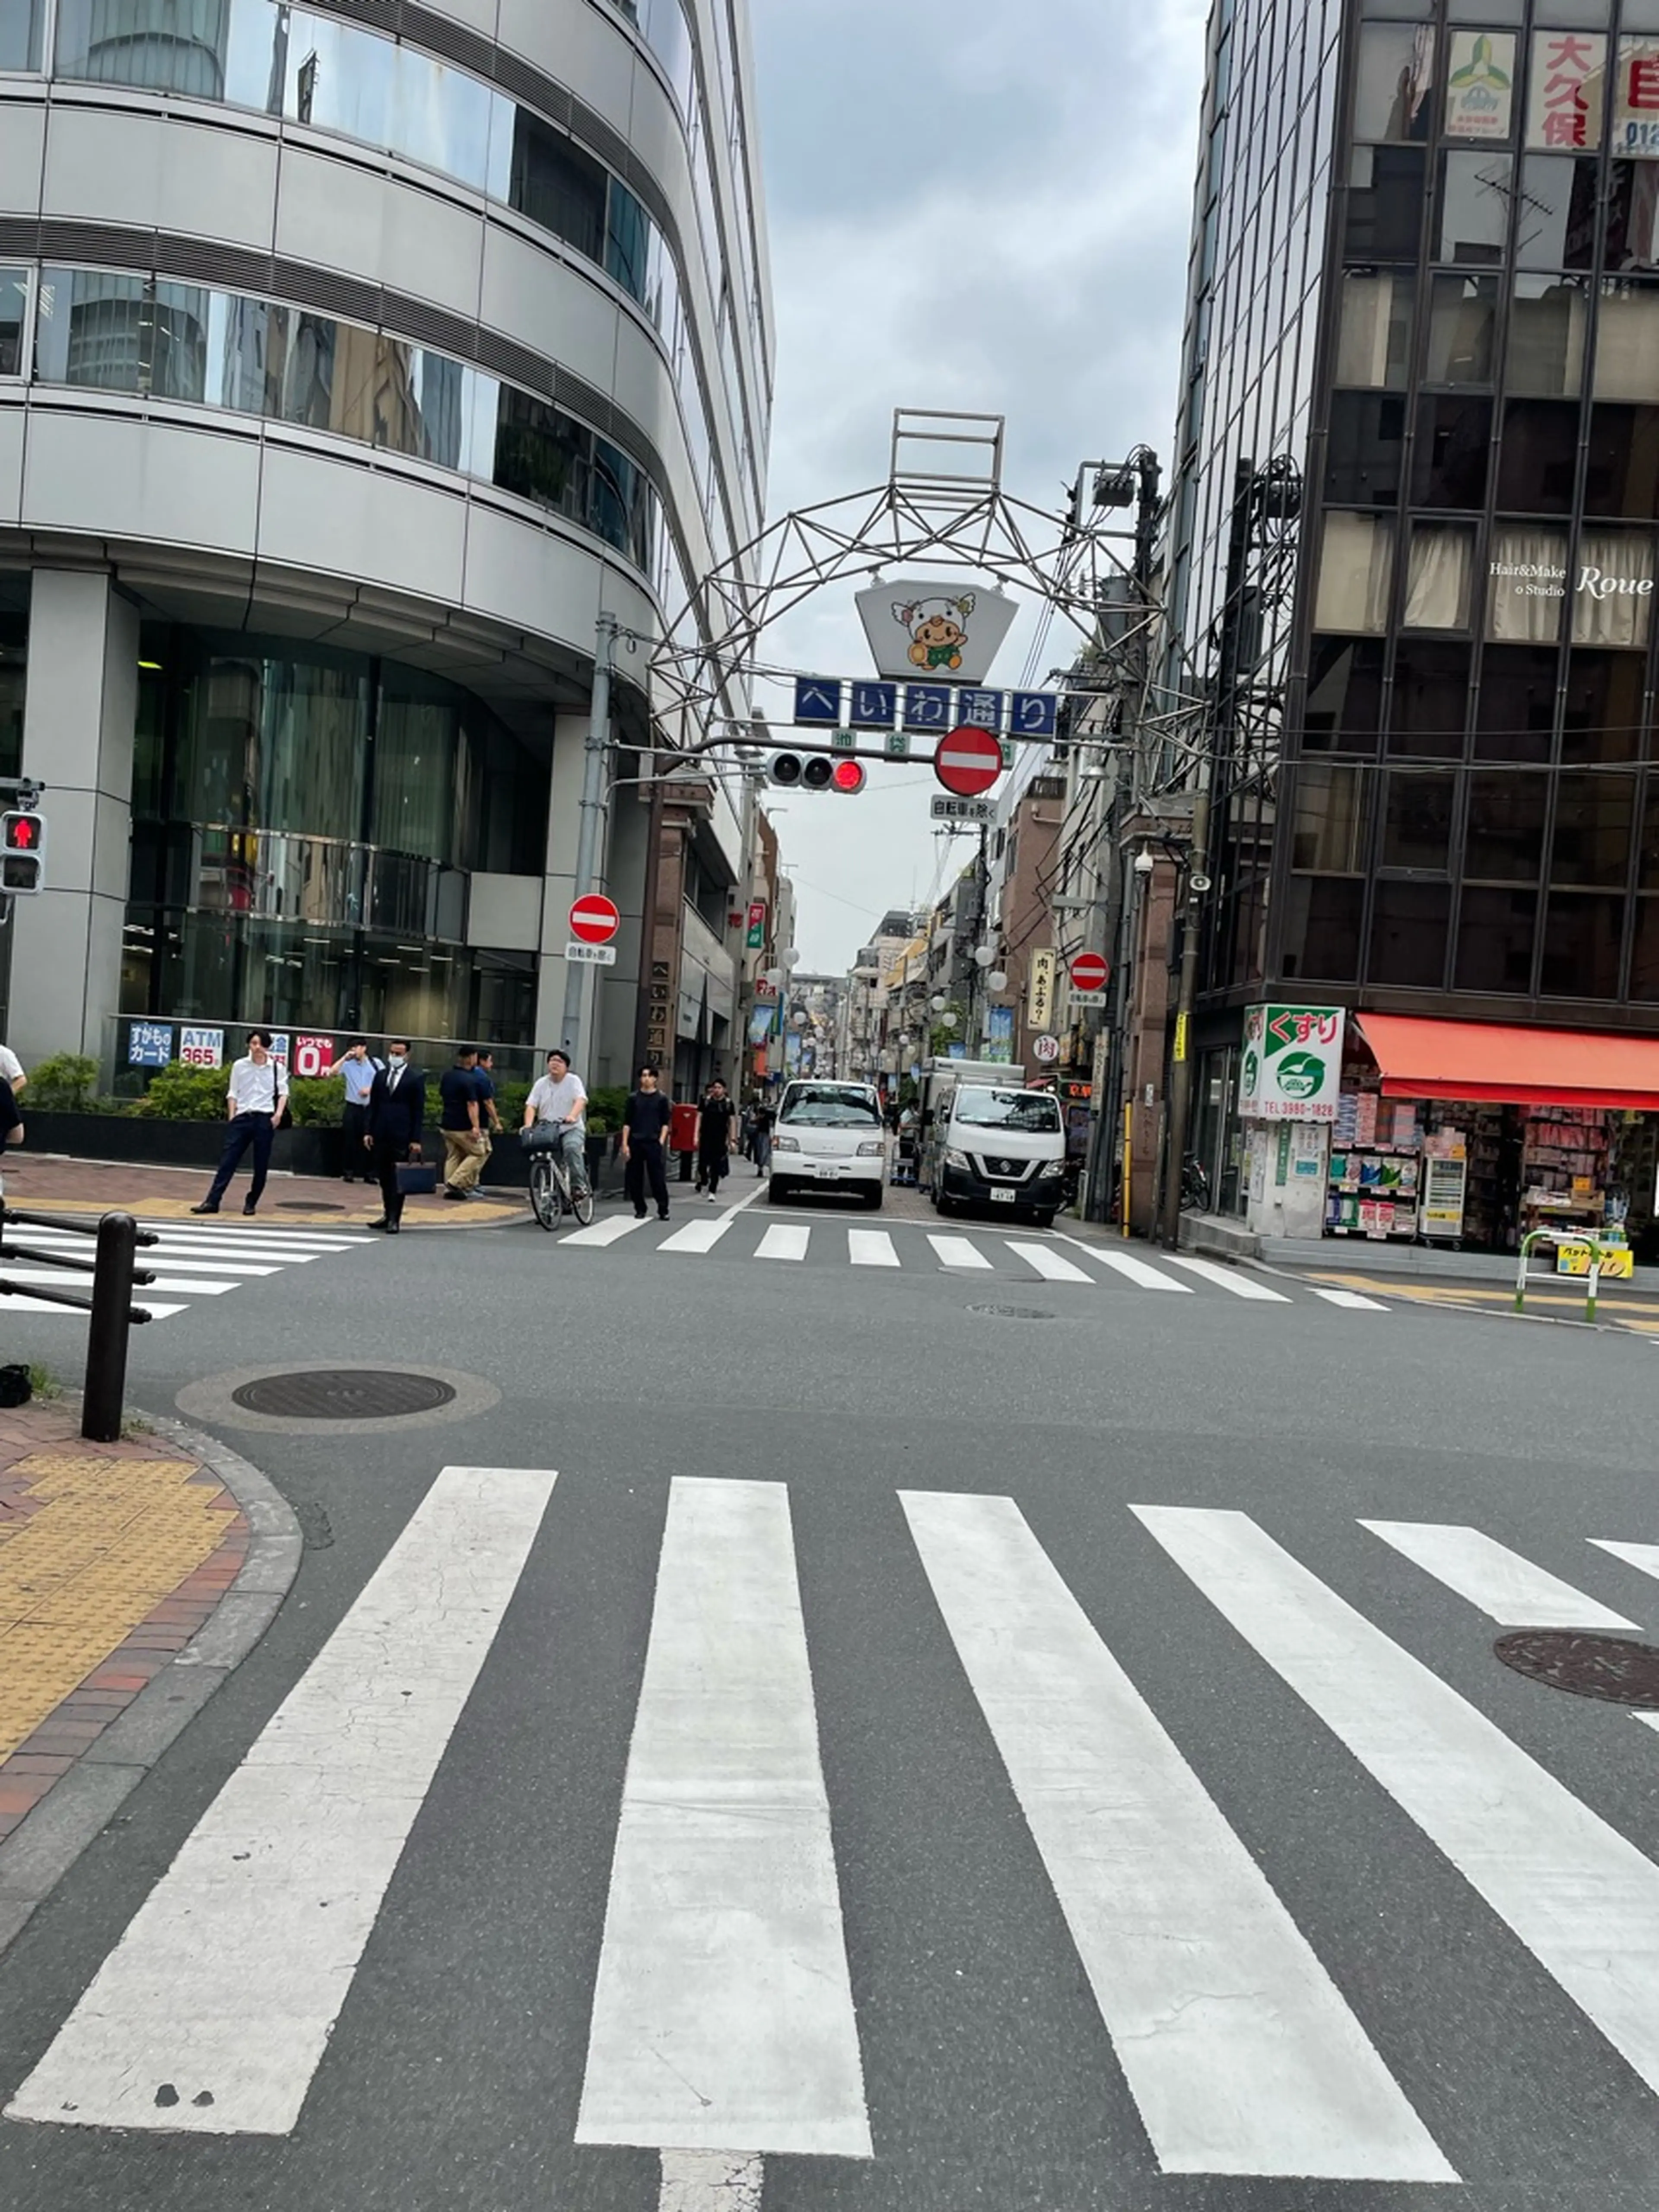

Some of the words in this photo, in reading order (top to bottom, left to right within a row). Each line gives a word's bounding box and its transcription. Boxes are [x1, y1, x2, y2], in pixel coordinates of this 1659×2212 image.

[1541, 35, 1592, 147] 大久保
[1490, 563, 1567, 579] Hair&Make
[1576, 566, 1654, 600] Roue
[1526, 585, 1566, 597] Studio
[801, 686, 1046, 729] へいわ通り
[934, 800, 995, 819] 自転車を除く
[649, 965, 668, 1066] へいわ通り
[131, 1026, 172, 1046] すがもの
[1269, 1011, 1338, 1045] くすり
[182, 1030, 222, 1049] ATM
[296, 1036, 333, 1049] いつでも
[130, 1046, 169, 1064] カード
[182, 1047, 214, 1065] 365
[1264, 1101, 1280, 1114] TEL
